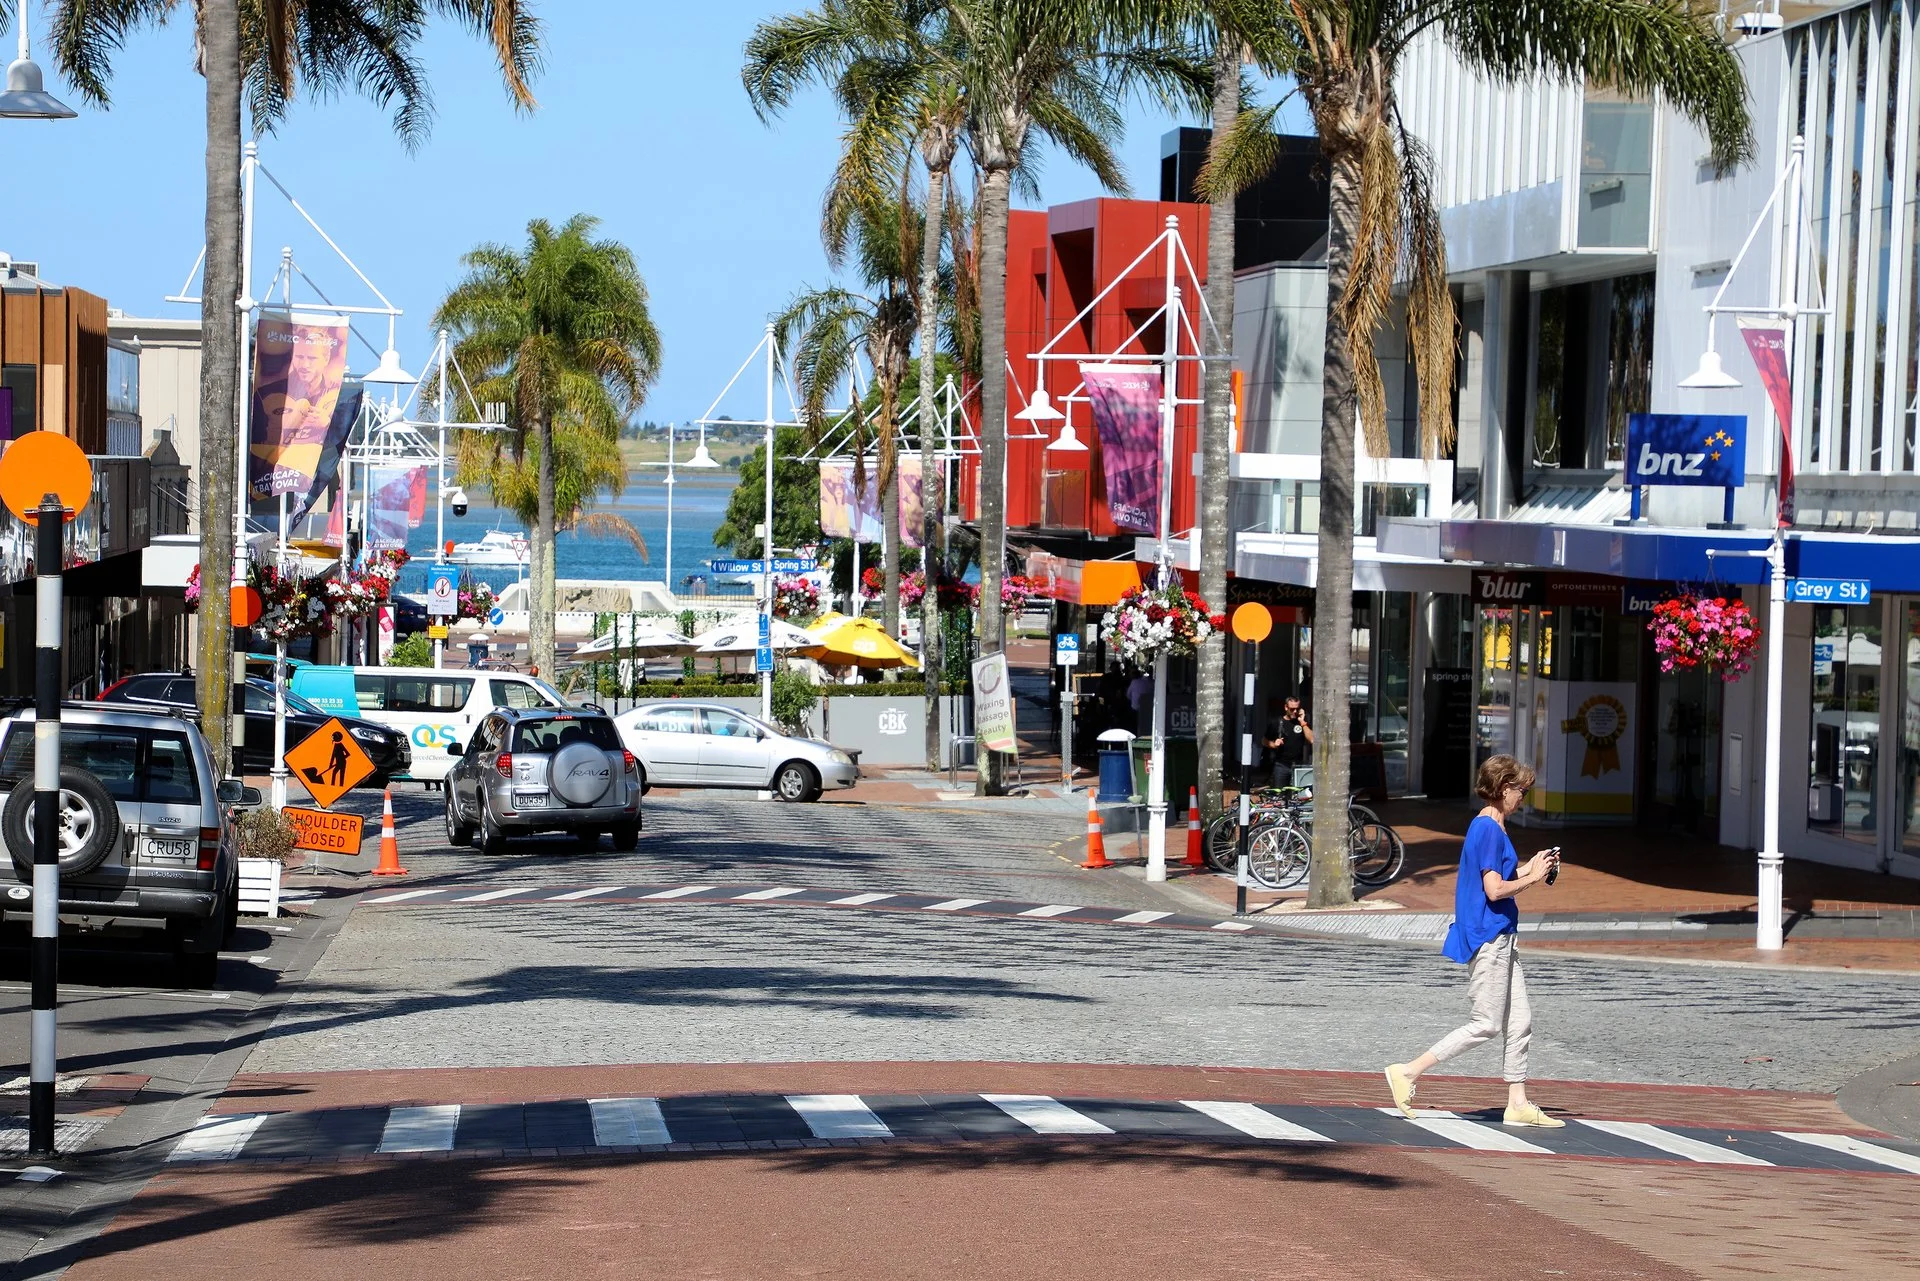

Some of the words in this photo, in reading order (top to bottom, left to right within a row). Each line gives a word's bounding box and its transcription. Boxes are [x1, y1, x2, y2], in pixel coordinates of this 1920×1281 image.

[279, 334, 299, 344] NZC
[1637, 443, 1706, 477] bnz
[275, 479, 299, 489] OVAL
[719, 562, 748, 572] Willow
[752, 562, 762, 572] St
[774, 560, 799, 571] Spring
[800, 559, 810, 570] St
[1481, 576, 1531, 599] blur
[1551, 583, 1617, 591] OPTOMETRISTS
[1794, 580, 1833, 600] Grey
[1839, 582, 1858, 598] St
[1629, 596, 1659, 611] bnz
[1432, 672, 1459, 683] spring
[976, 699, 1004, 711] Waxing
[879, 713, 907, 730] CBK
[1171, 711, 1197, 728] CBK
[412, 724, 457, 748] OCS
[299, 830, 345, 848] LOSED
[148, 841, 191, 856] CRU58
